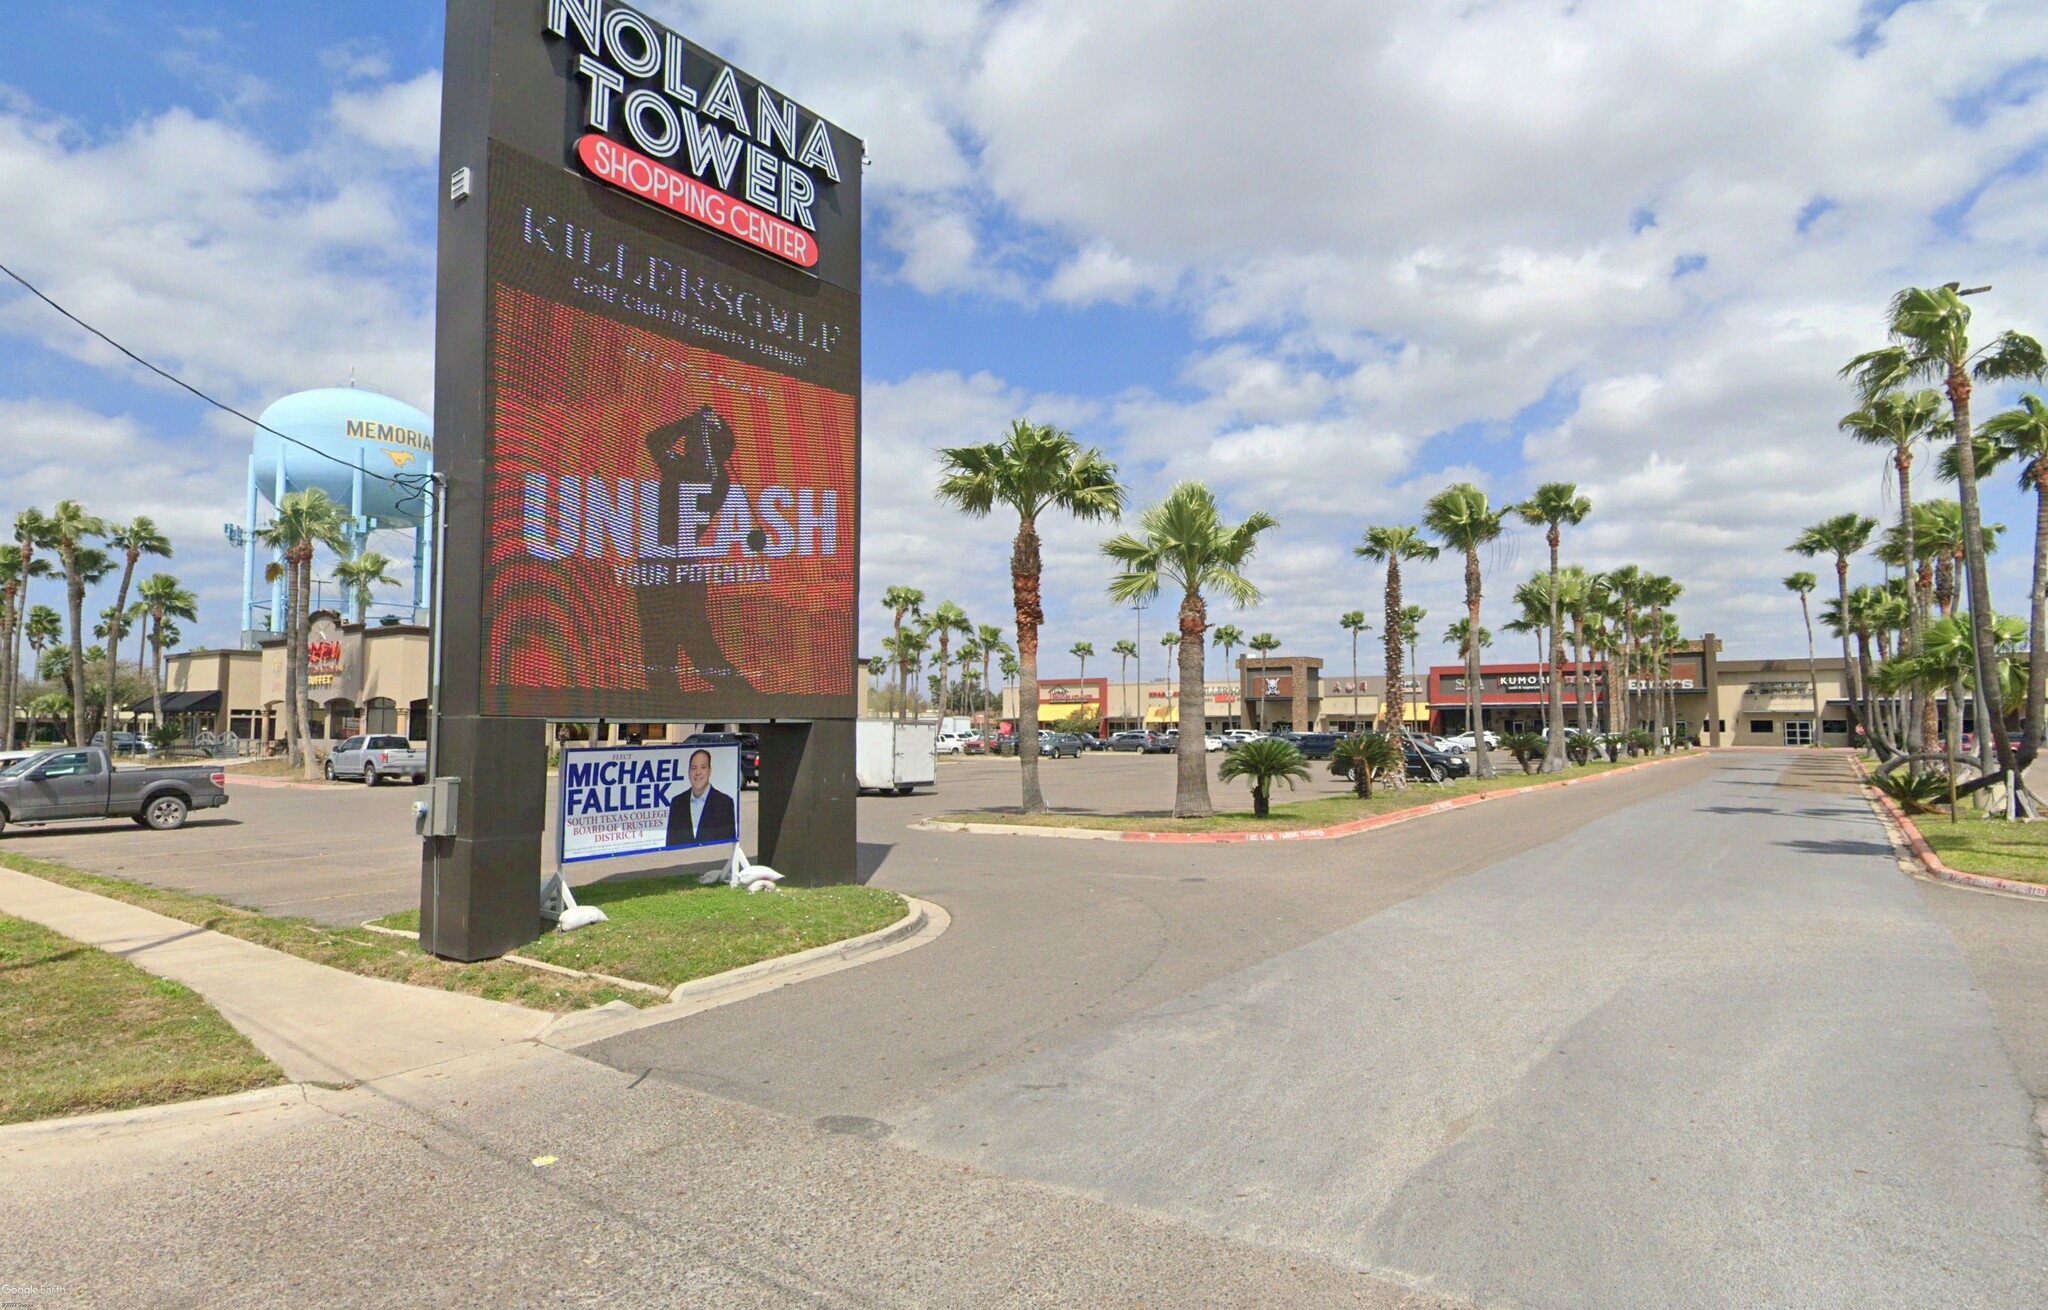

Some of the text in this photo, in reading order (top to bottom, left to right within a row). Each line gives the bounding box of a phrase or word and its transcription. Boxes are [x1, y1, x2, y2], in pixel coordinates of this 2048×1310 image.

[546, 0, 840, 183] NOLANA
[578, 54, 816, 231] TOWER
[594, 141, 807, 264] SHOPPING CENTER
[346, 419, 433, 452] MEMORIA
[523, 472, 838, 560] UNLEASH
[614, 562, 770, 585] YOUR POTENTIAL
[308, 674, 333, 685] UFFET
[1500, 676, 1550, 685] KUMORI
[568, 759, 684, 788] MICHAEL
[568, 783, 672, 815] FALLEK
[567, 809, 669, 827] SOUTH TEXAS COLLEGE
[573, 819, 664, 836] BOARD OF TRUSTEES
[594, 830, 643, 843] DISTRICT 4
